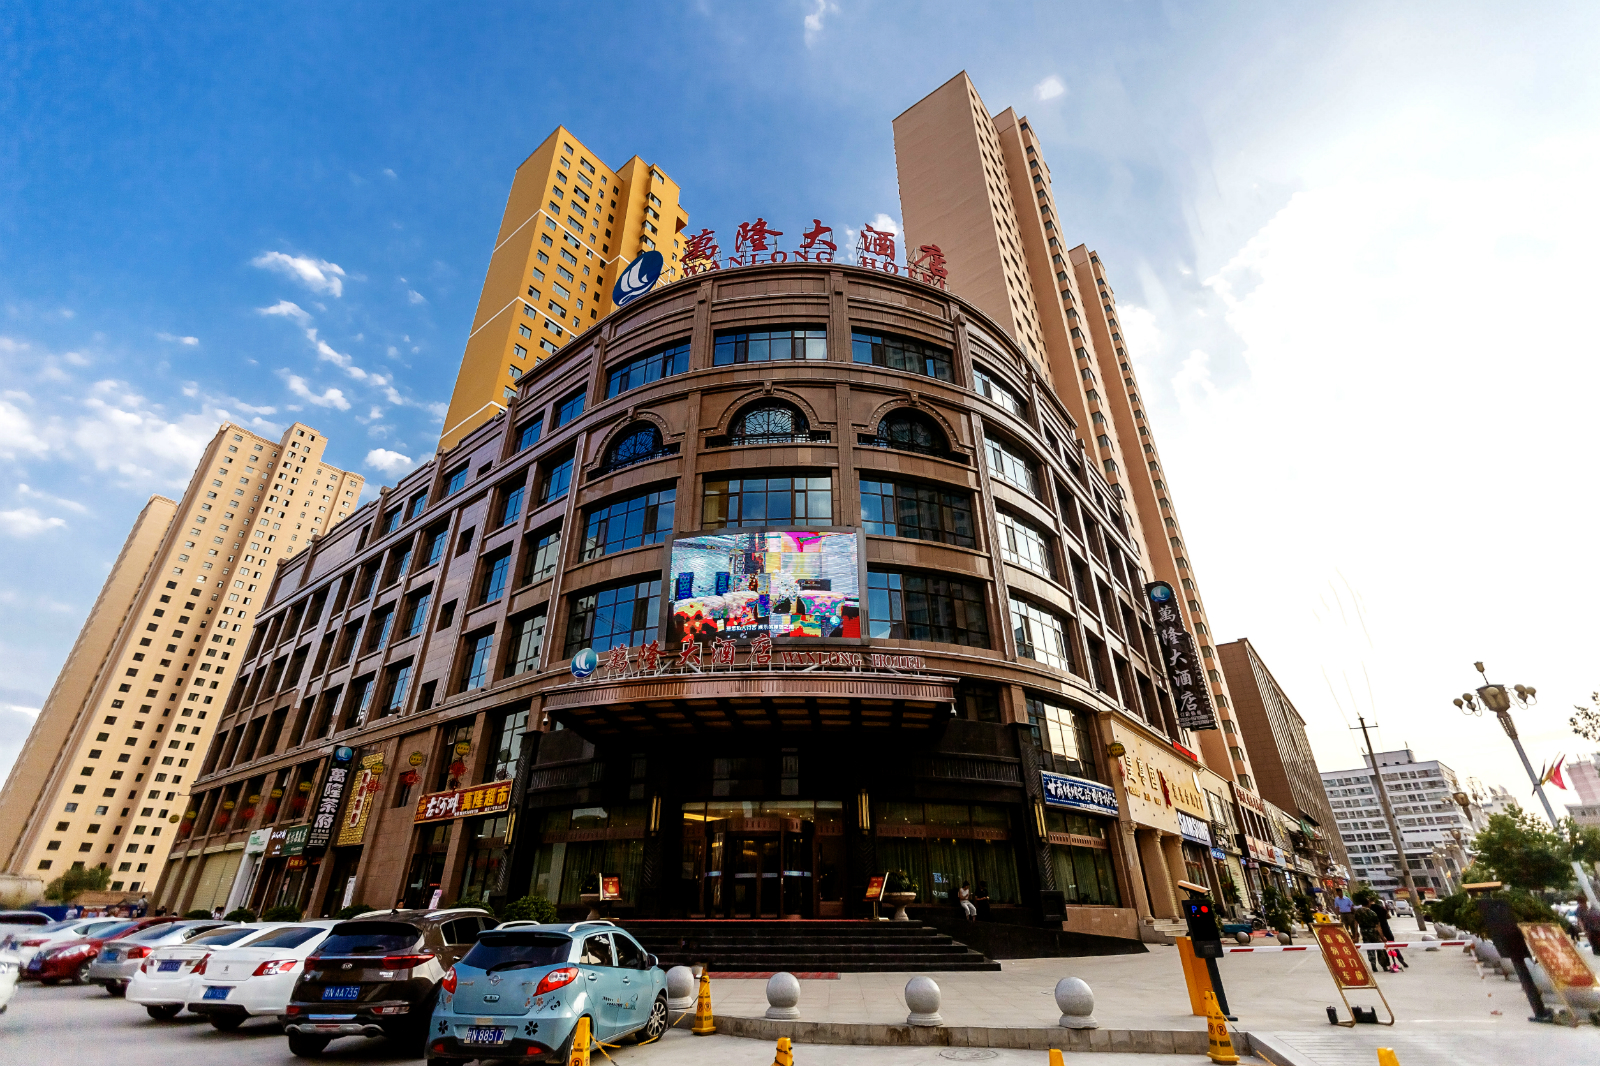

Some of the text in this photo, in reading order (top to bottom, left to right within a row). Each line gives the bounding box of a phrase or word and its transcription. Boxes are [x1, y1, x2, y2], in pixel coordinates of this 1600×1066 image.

[679, 217, 948, 279] 萬隆大酒店
[682, 251, 945, 289] WANLONG HOTEL
[603, 633, 773, 672] 萬隆大酒店
[781, 651, 926, 669] WANLONG HOTEL
[1158, 605, 1197, 712] 萬隆大酒店
[314, 768, 347, 828] 萬隆茶府
